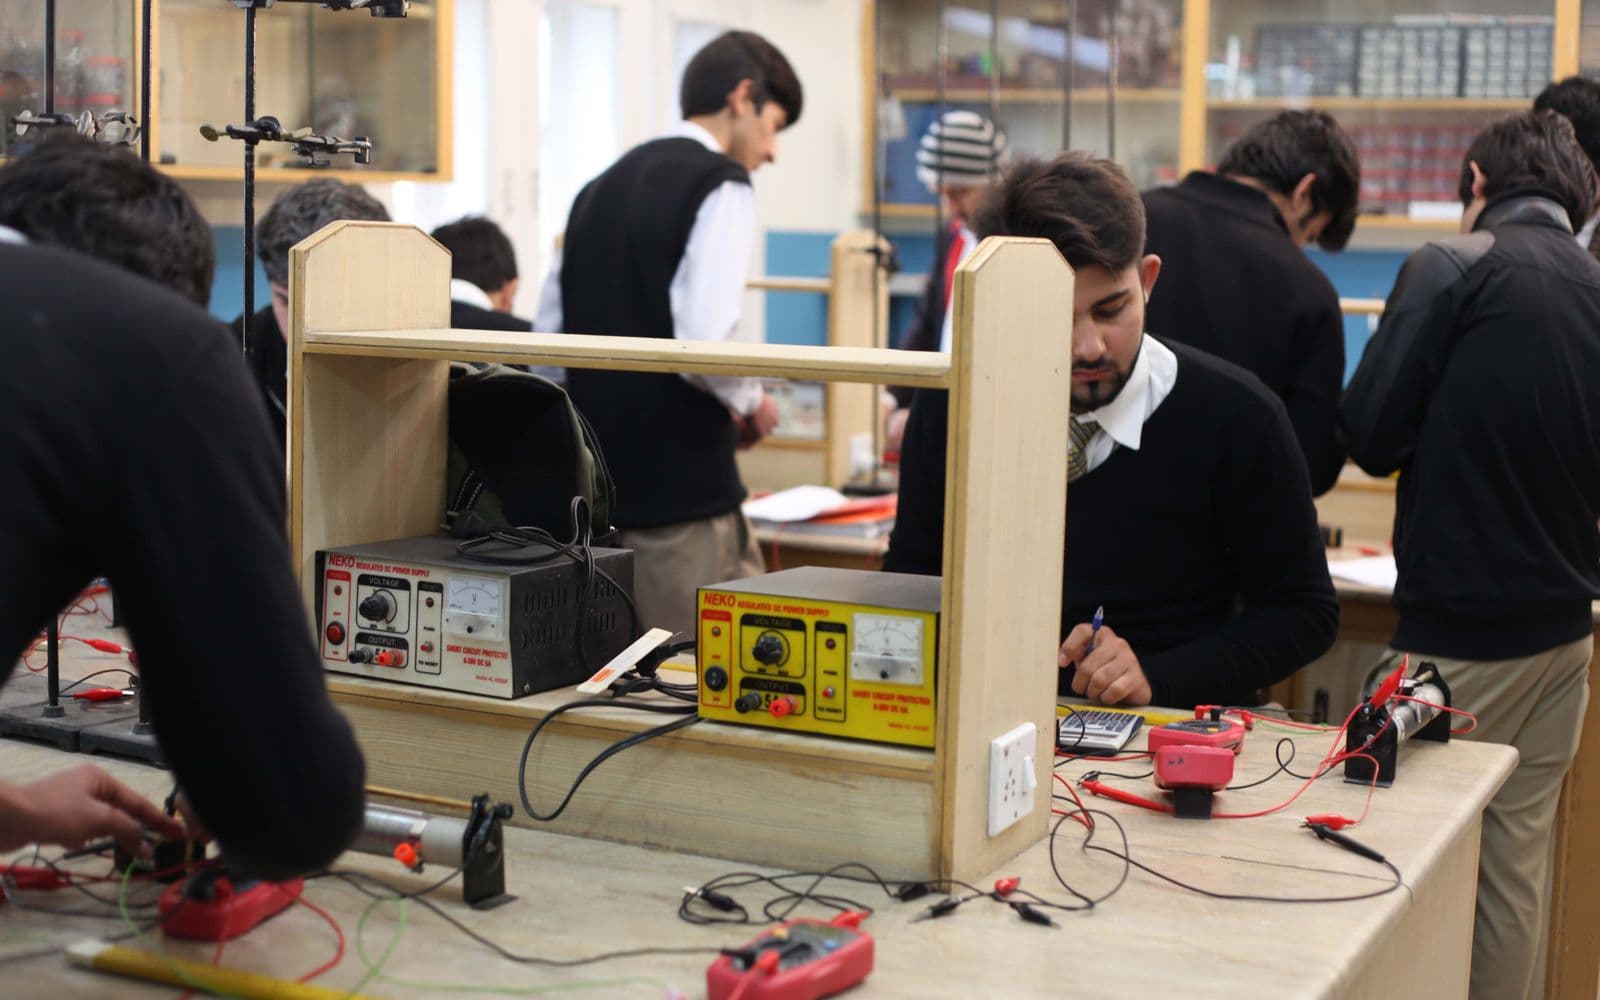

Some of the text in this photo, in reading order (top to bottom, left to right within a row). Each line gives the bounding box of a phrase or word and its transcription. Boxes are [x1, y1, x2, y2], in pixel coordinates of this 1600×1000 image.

[328, 553, 355, 568] NEKO
[356, 562, 384, 572] REGULATED
[393, 567, 411, 575] POWER
[411, 569, 430, 577] SUPPLY
[369, 577, 399, 587] VOLTAGE
[703, 592, 737, 607] NEKO
[783, 605, 805, 614] POWER
[368, 635, 395, 646] OUTPUT
